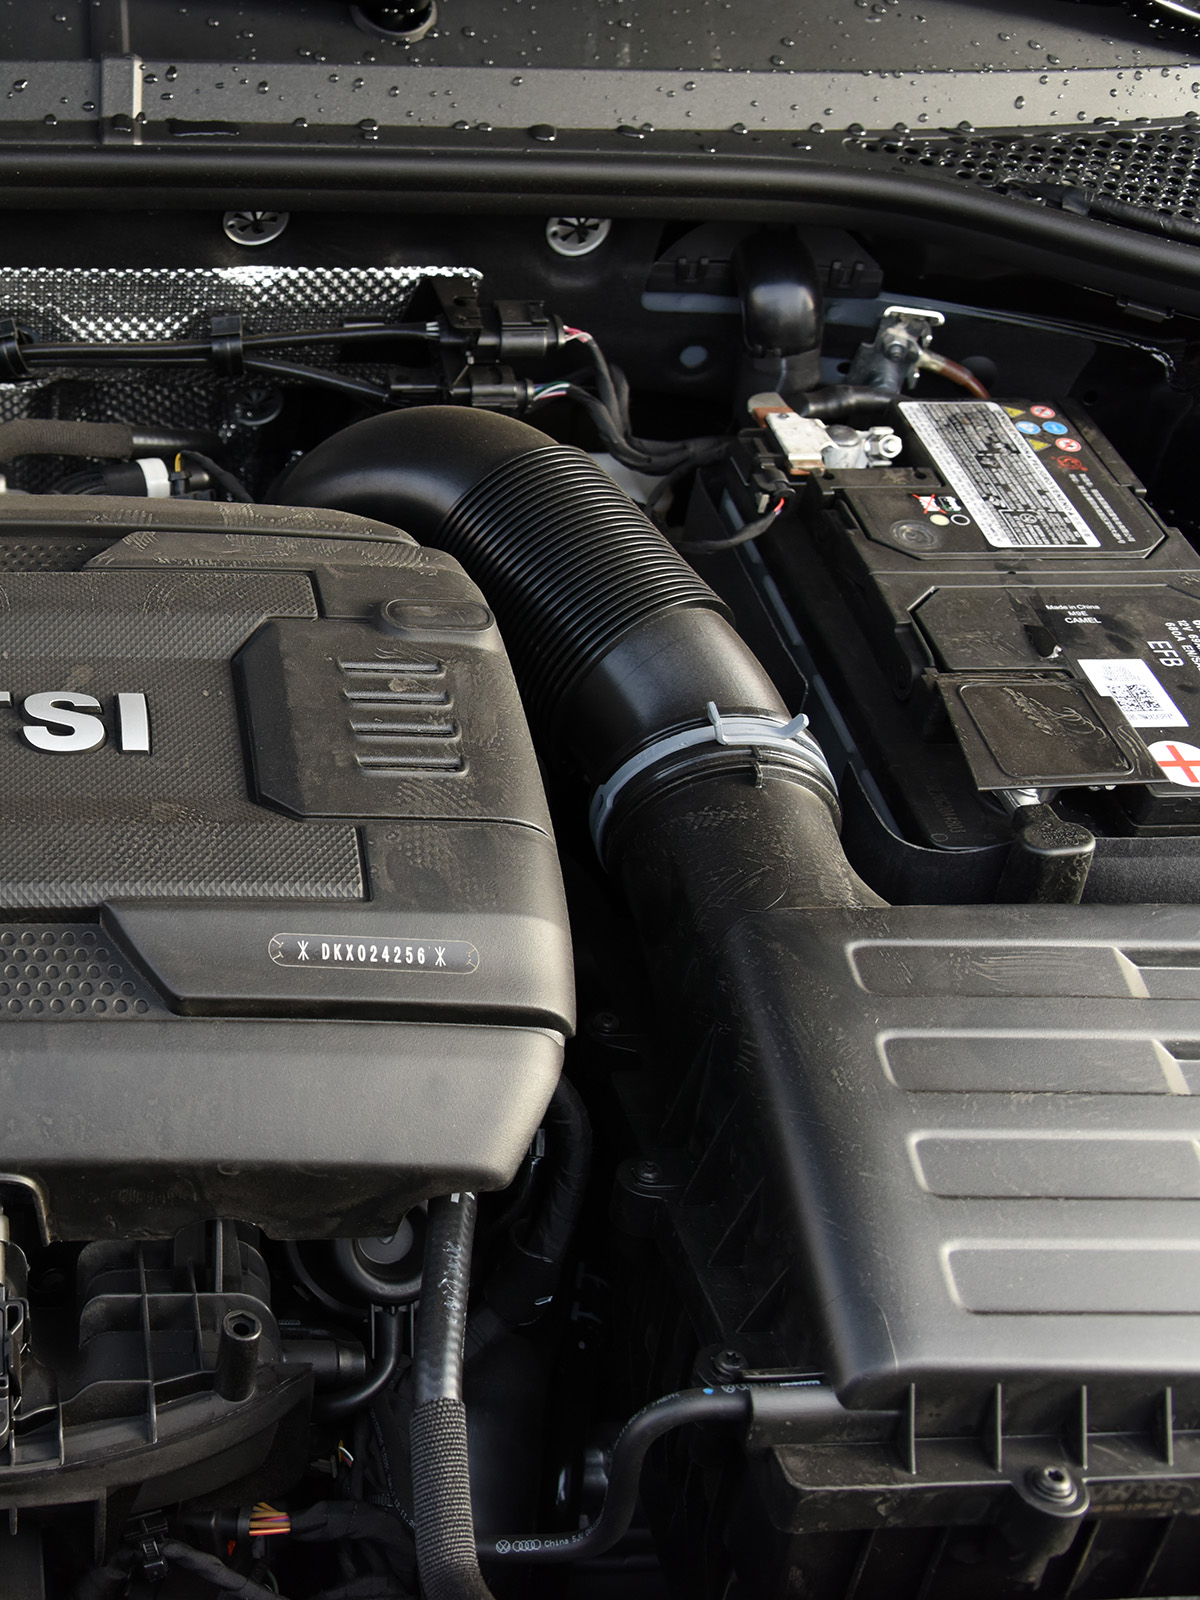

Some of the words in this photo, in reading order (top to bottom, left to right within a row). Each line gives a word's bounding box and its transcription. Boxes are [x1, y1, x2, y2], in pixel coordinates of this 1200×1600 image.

[1165, 622, 1186, 642] 680A
[1177, 620, 1194, 631] 12V
[1147, 641, 1185, 667] EFB
[321, 942, 425, 964] DKX024256
[544, 1539, 569, 1548] China
